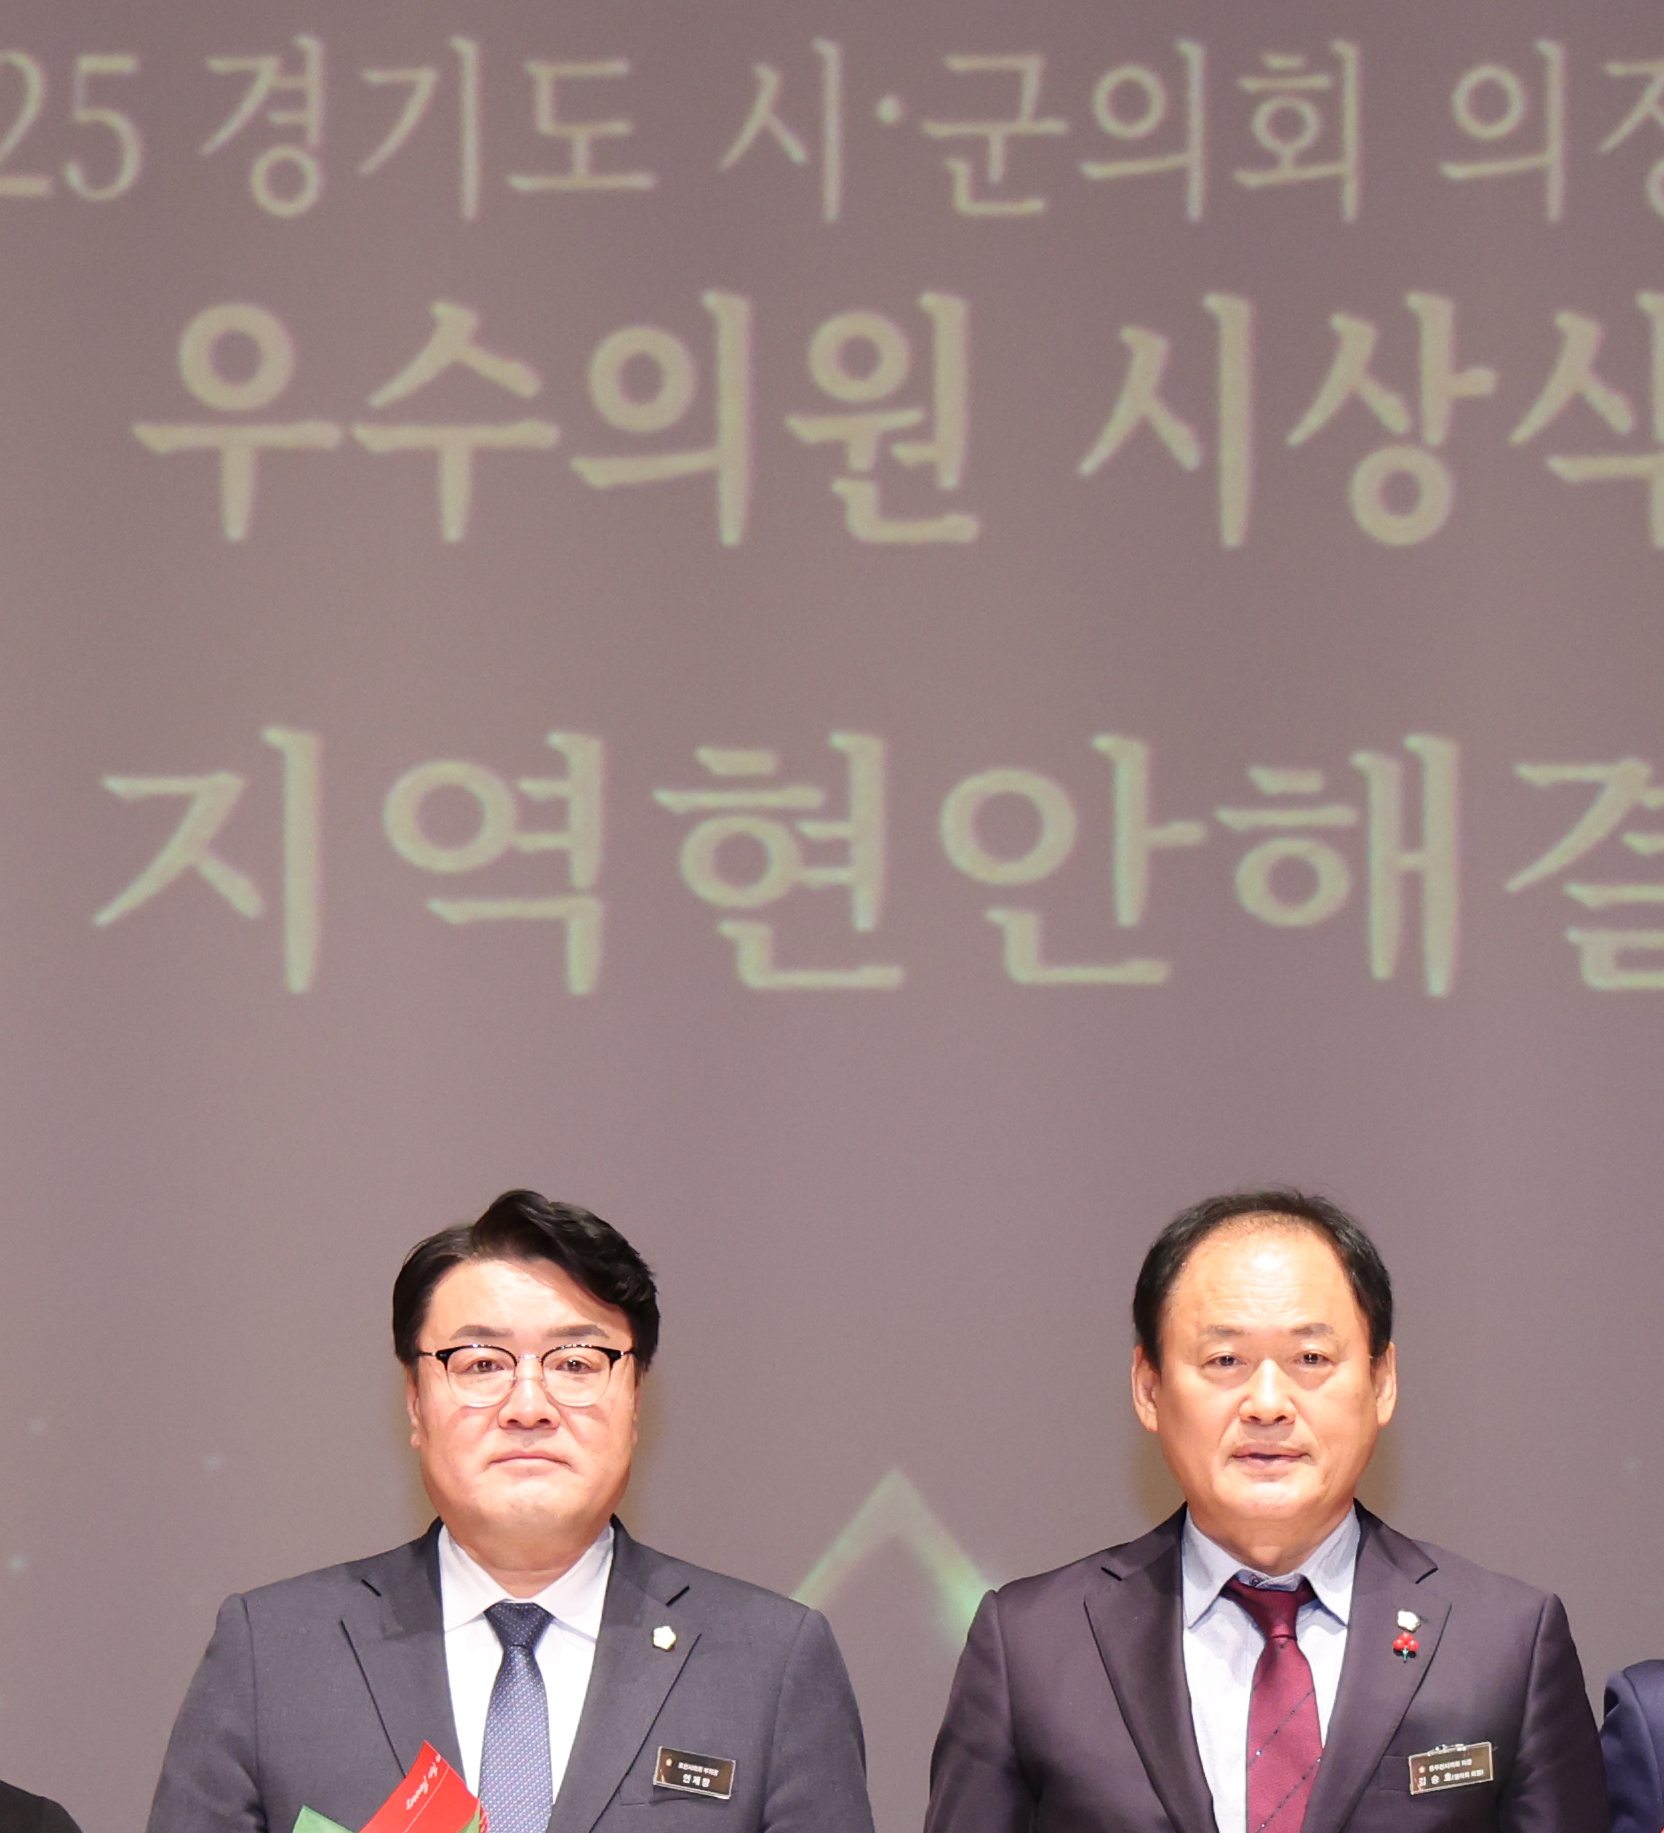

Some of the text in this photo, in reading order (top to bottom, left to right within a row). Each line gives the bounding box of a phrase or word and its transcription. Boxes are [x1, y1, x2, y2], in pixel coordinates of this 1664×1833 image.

[200, 34, 658, 221] 경기도
[718, 36, 1360, 222] 시·군의회
[133, 290, 980, 546] 우수의원
